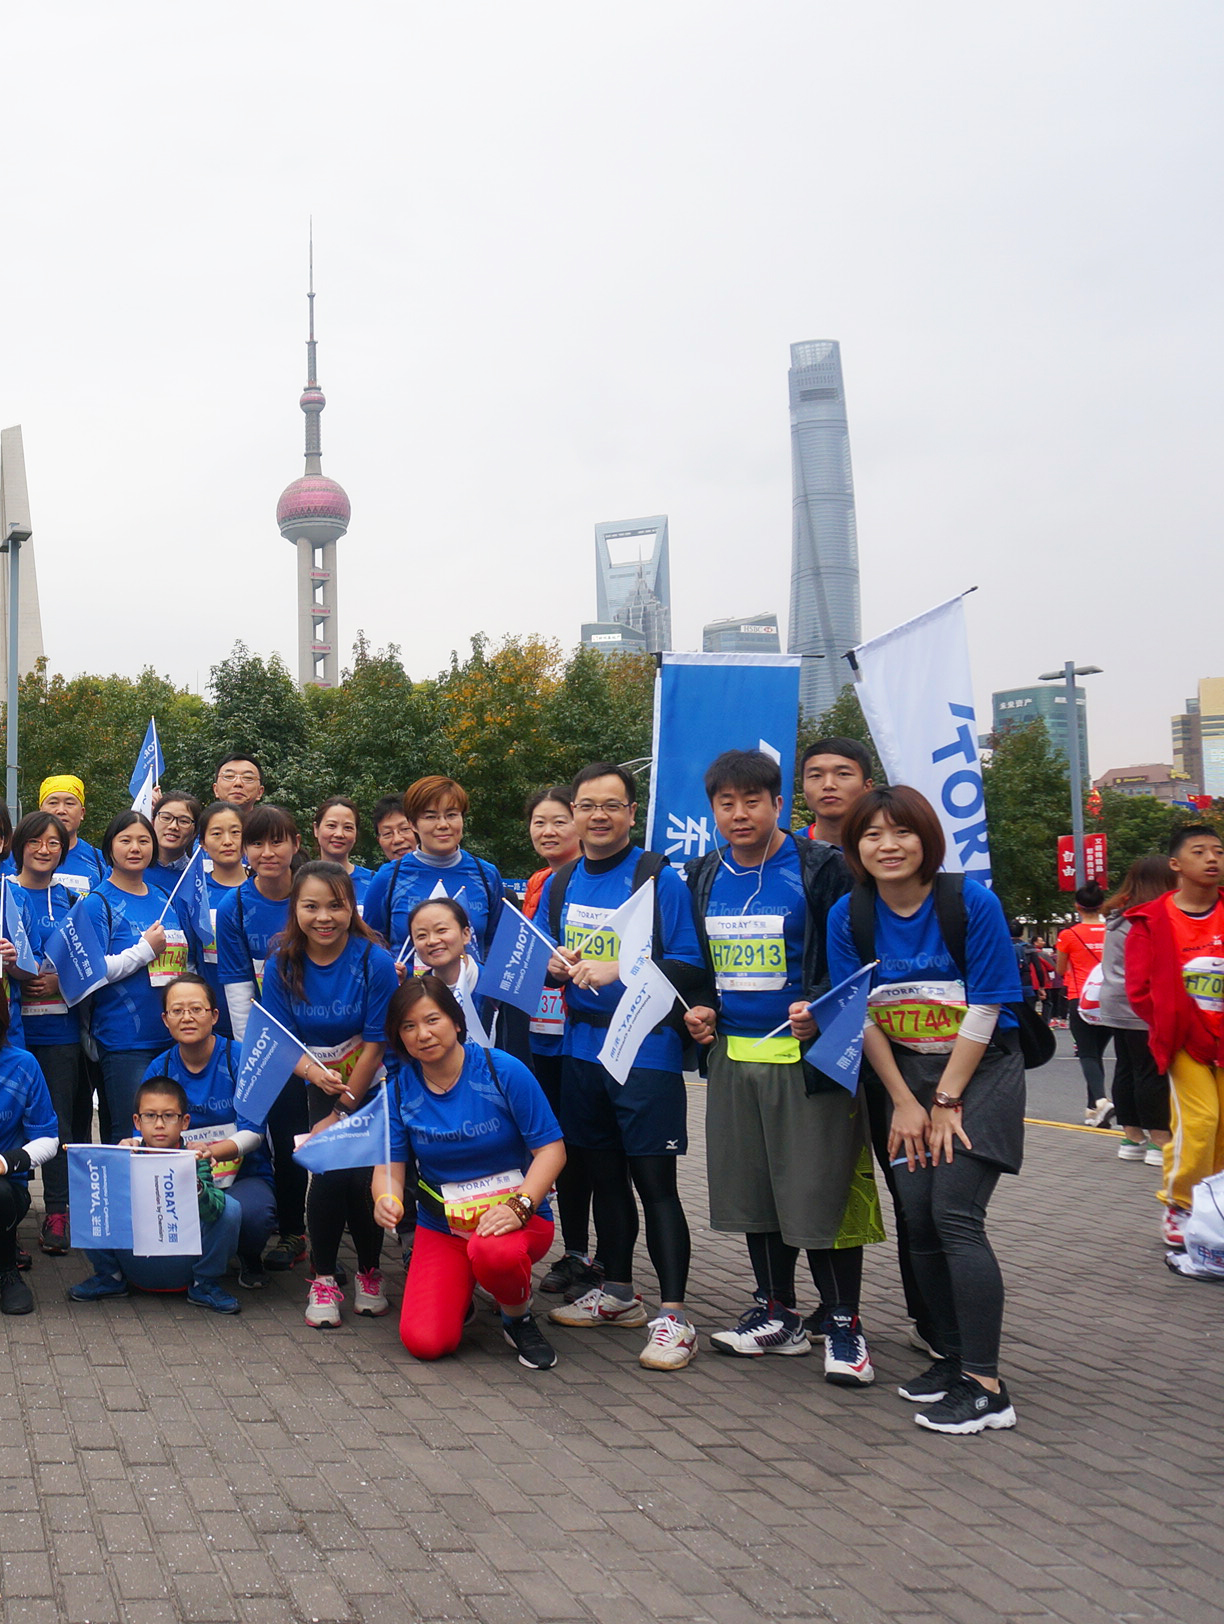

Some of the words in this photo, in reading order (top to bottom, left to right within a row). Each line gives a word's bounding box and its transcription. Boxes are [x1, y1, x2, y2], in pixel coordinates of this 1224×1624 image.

[713, 944, 782, 967] H72913
[880, 953, 913, 972] Toray
[430, 1127, 462, 1142] Toray
[462, 1117, 501, 1138] Group
